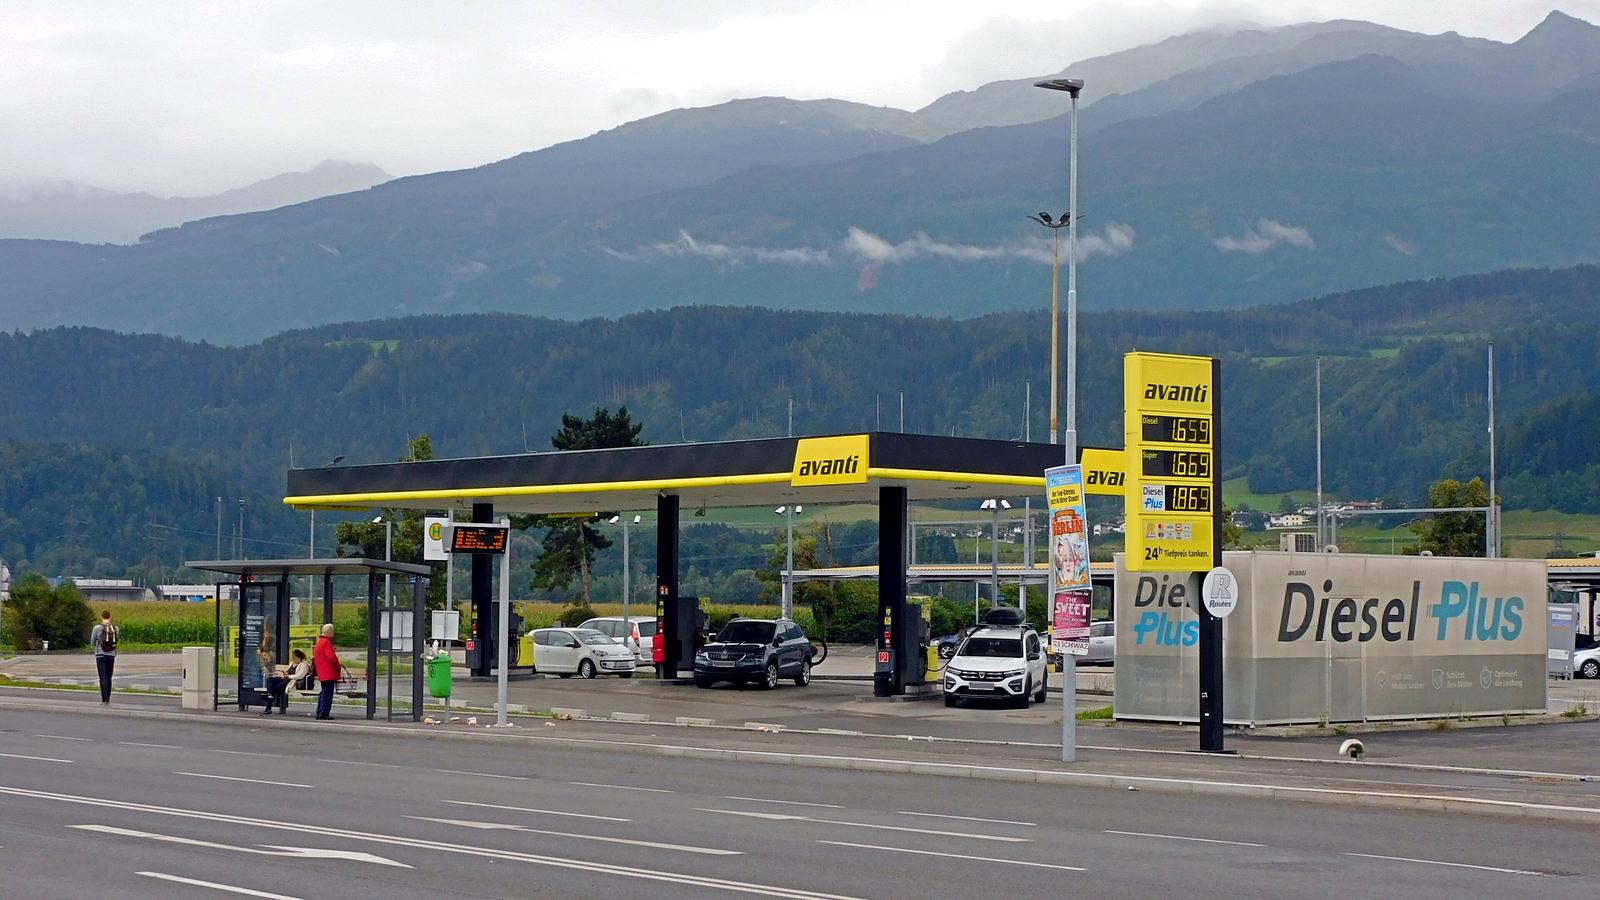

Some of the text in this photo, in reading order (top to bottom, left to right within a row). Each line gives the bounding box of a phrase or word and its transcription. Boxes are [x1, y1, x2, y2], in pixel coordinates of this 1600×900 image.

[1144, 383, 1208, 403] avanti
[1142, 416, 1209, 442] Diesel 1.659
[799, 455, 859, 476] avanti
[1142, 451, 1209, 476] Super 1.669
[1143, 486, 1164, 496] Diesel
[1144, 487, 1209, 511] Plus 1.869
[1164, 549, 1188, 559] Tiefpreis
[1135, 574, 1190, 608] Die
[1055, 602, 1090, 616] SWEET
[1277, 578, 1525, 643] Diesel Plus
[1132, 610, 1199, 647] Plus
[1061, 641, 1089, 650] SCHWAZ
